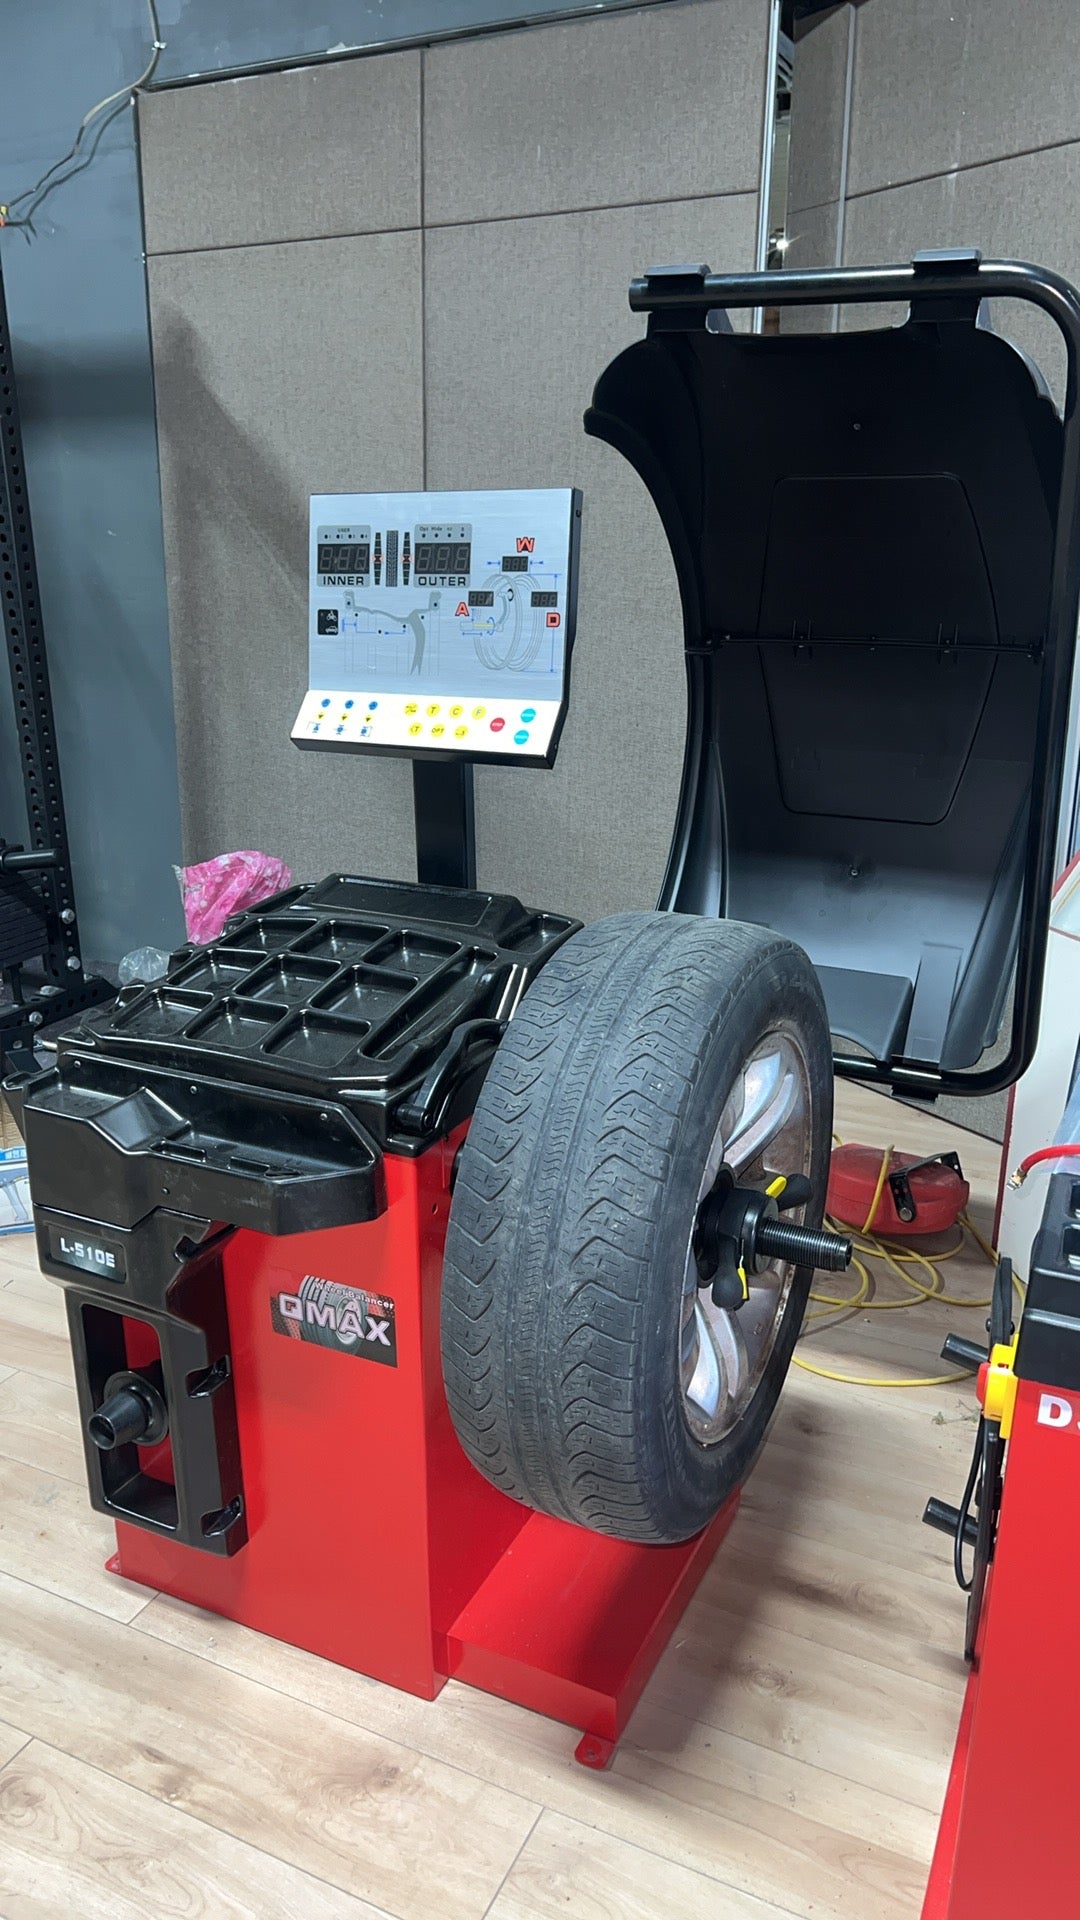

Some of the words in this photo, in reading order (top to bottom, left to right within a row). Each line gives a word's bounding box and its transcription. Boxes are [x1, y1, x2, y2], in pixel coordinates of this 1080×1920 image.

[516, 536, 535, 553] W
[323, 576, 364, 586] INNER
[418, 576, 466, 586] OUTER
[454, 601, 470, 616] A
[546, 612, 561, 628] D
[314, 1282, 347, 1296] Wheel
[348, 1291, 394, 1310] Balancer
[279, 1291, 392, 1346] QMAX
